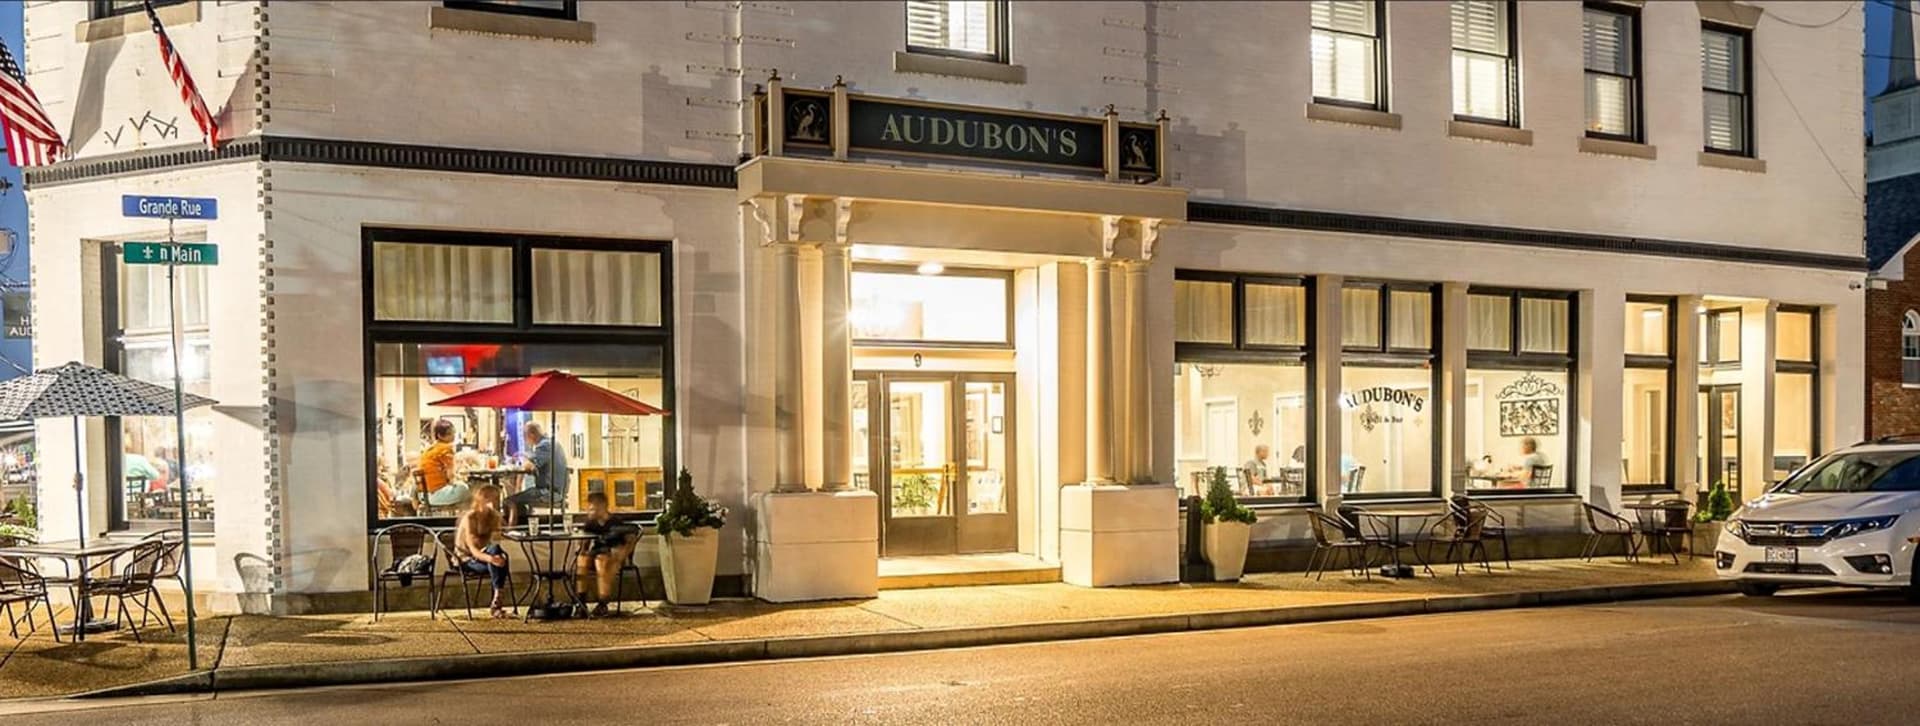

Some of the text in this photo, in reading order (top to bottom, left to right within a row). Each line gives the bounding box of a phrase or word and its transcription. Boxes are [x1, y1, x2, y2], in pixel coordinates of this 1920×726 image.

[881, 112, 1078, 157] AUDUBON'S
[139, 198, 201, 216] Grande Rue
[171, 245, 201, 262] Main
